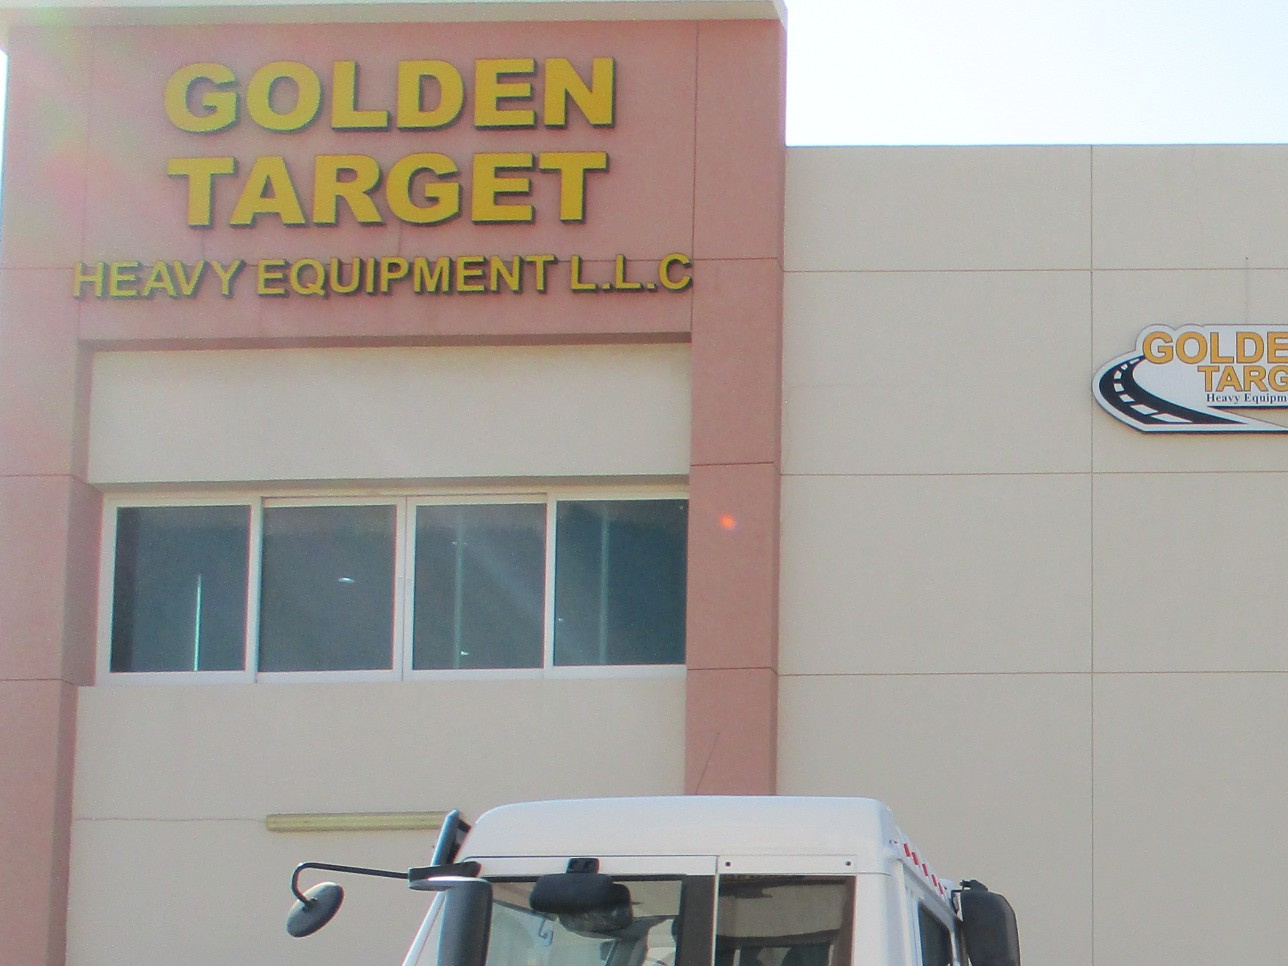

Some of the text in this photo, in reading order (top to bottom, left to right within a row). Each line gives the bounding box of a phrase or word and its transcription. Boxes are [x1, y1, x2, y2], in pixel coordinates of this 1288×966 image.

[163, 56, 618, 134] GOLDEN
[165, 150, 609, 229] TARGET
[73, 252, 694, 299] HEAVY EQUIPMENT L.L.C
[1206, 393, 1240, 405] Heavy
